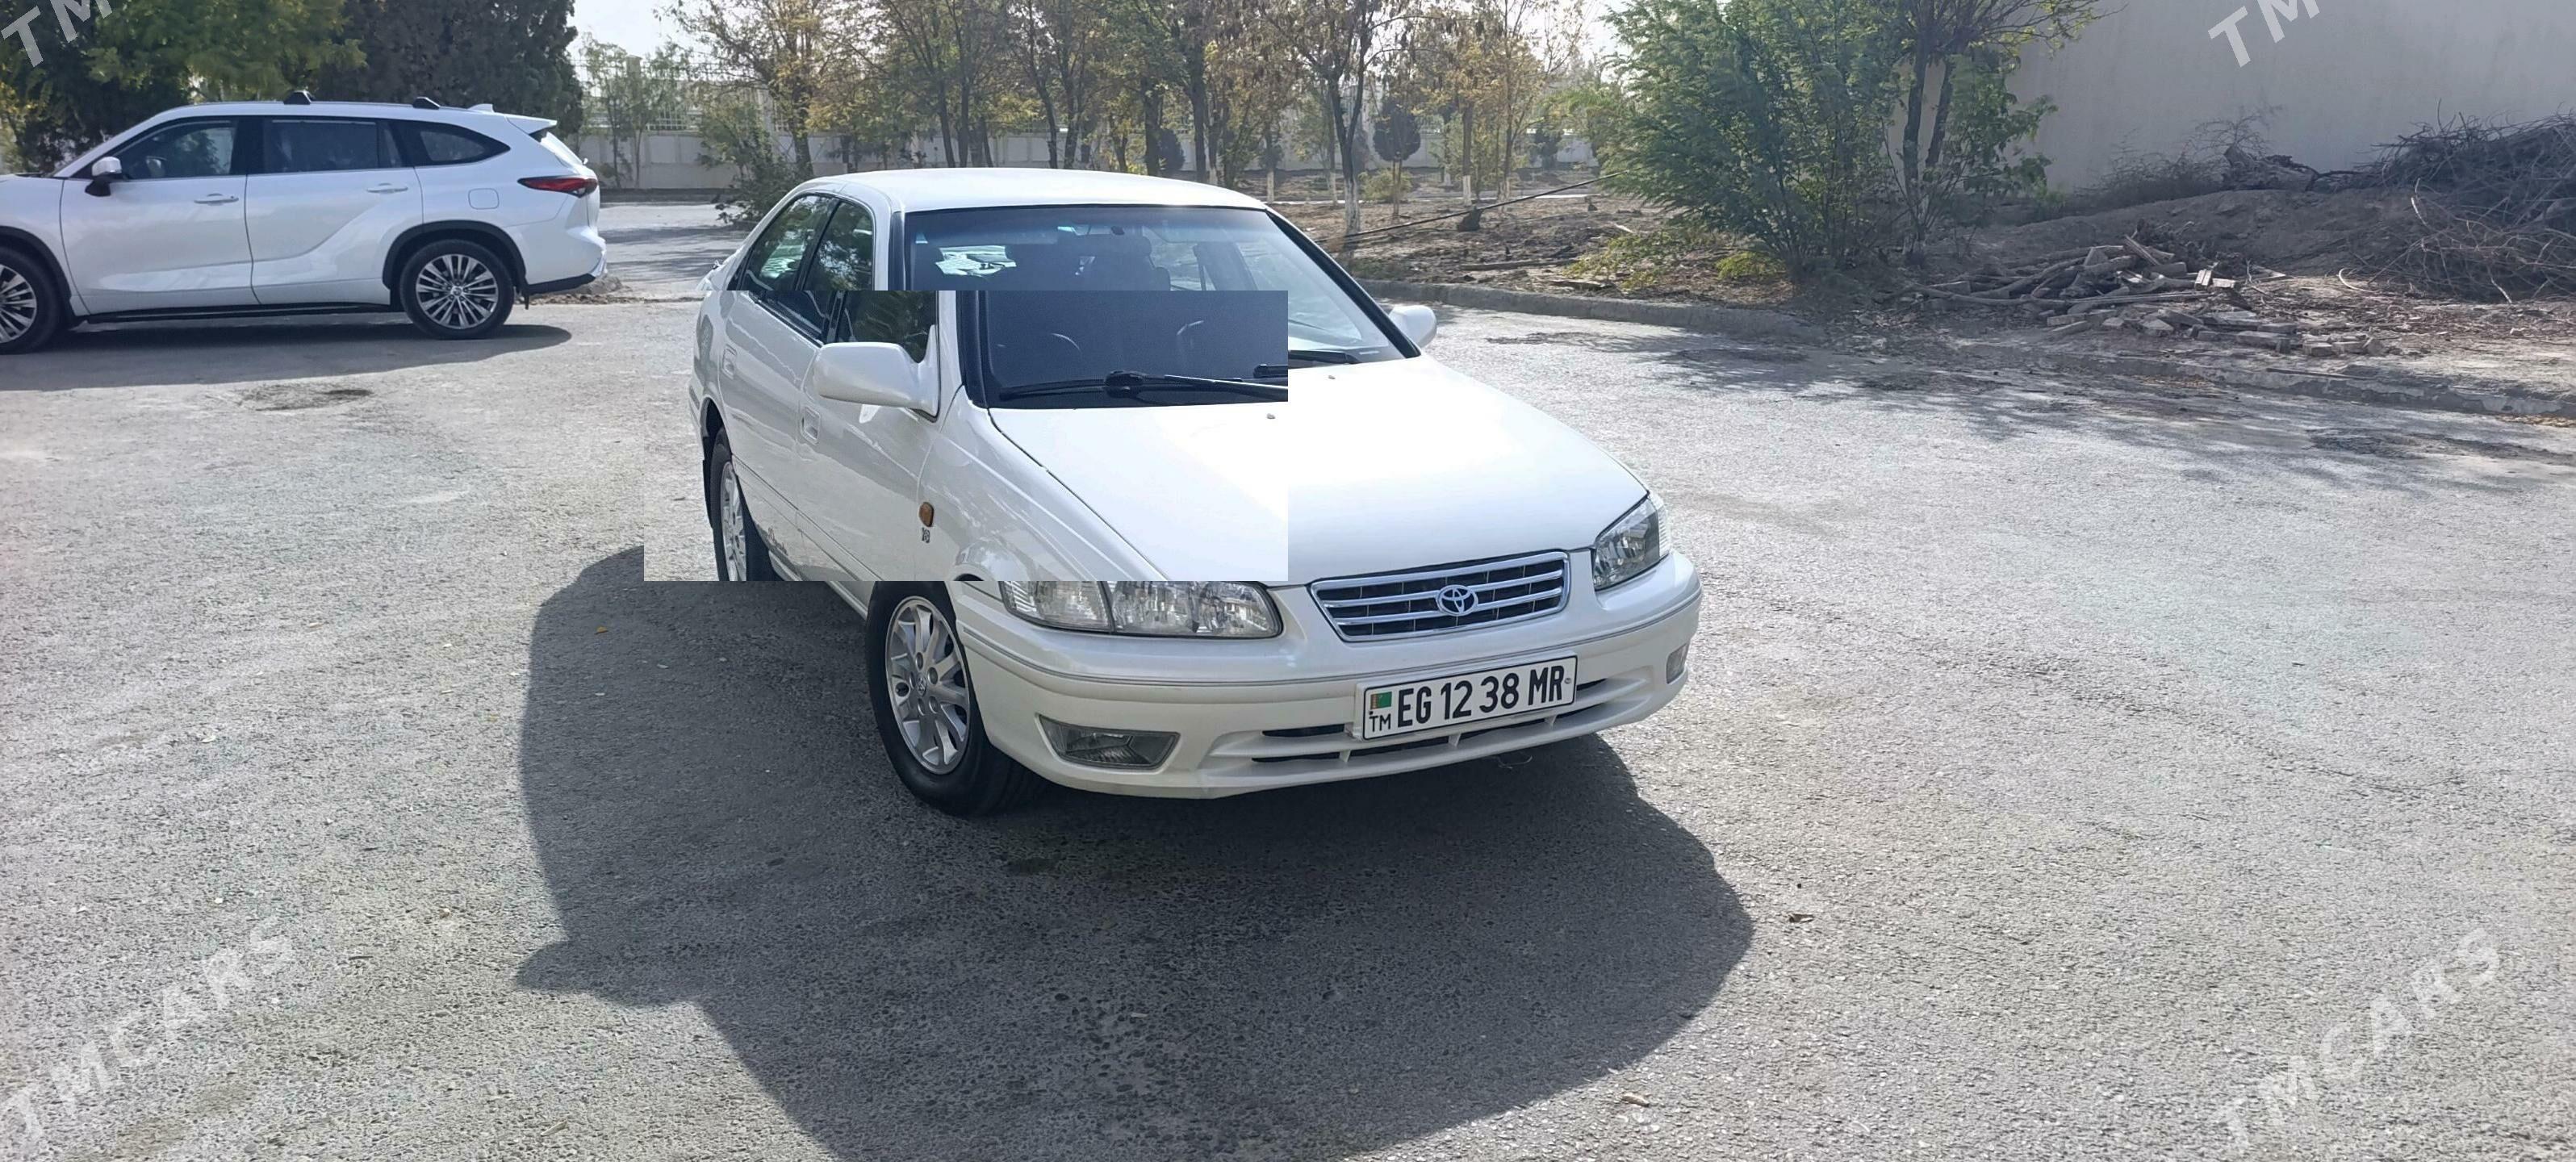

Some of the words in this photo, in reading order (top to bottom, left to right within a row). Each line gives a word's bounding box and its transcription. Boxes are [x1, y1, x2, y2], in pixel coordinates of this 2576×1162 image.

[1398, 687, 1432, 727] EG
[1441, 680, 1473, 720] 12
[1479, 673, 1520, 713] 38
[1528, 665, 1565, 706] MR
[1369, 713, 1391, 733] TM
